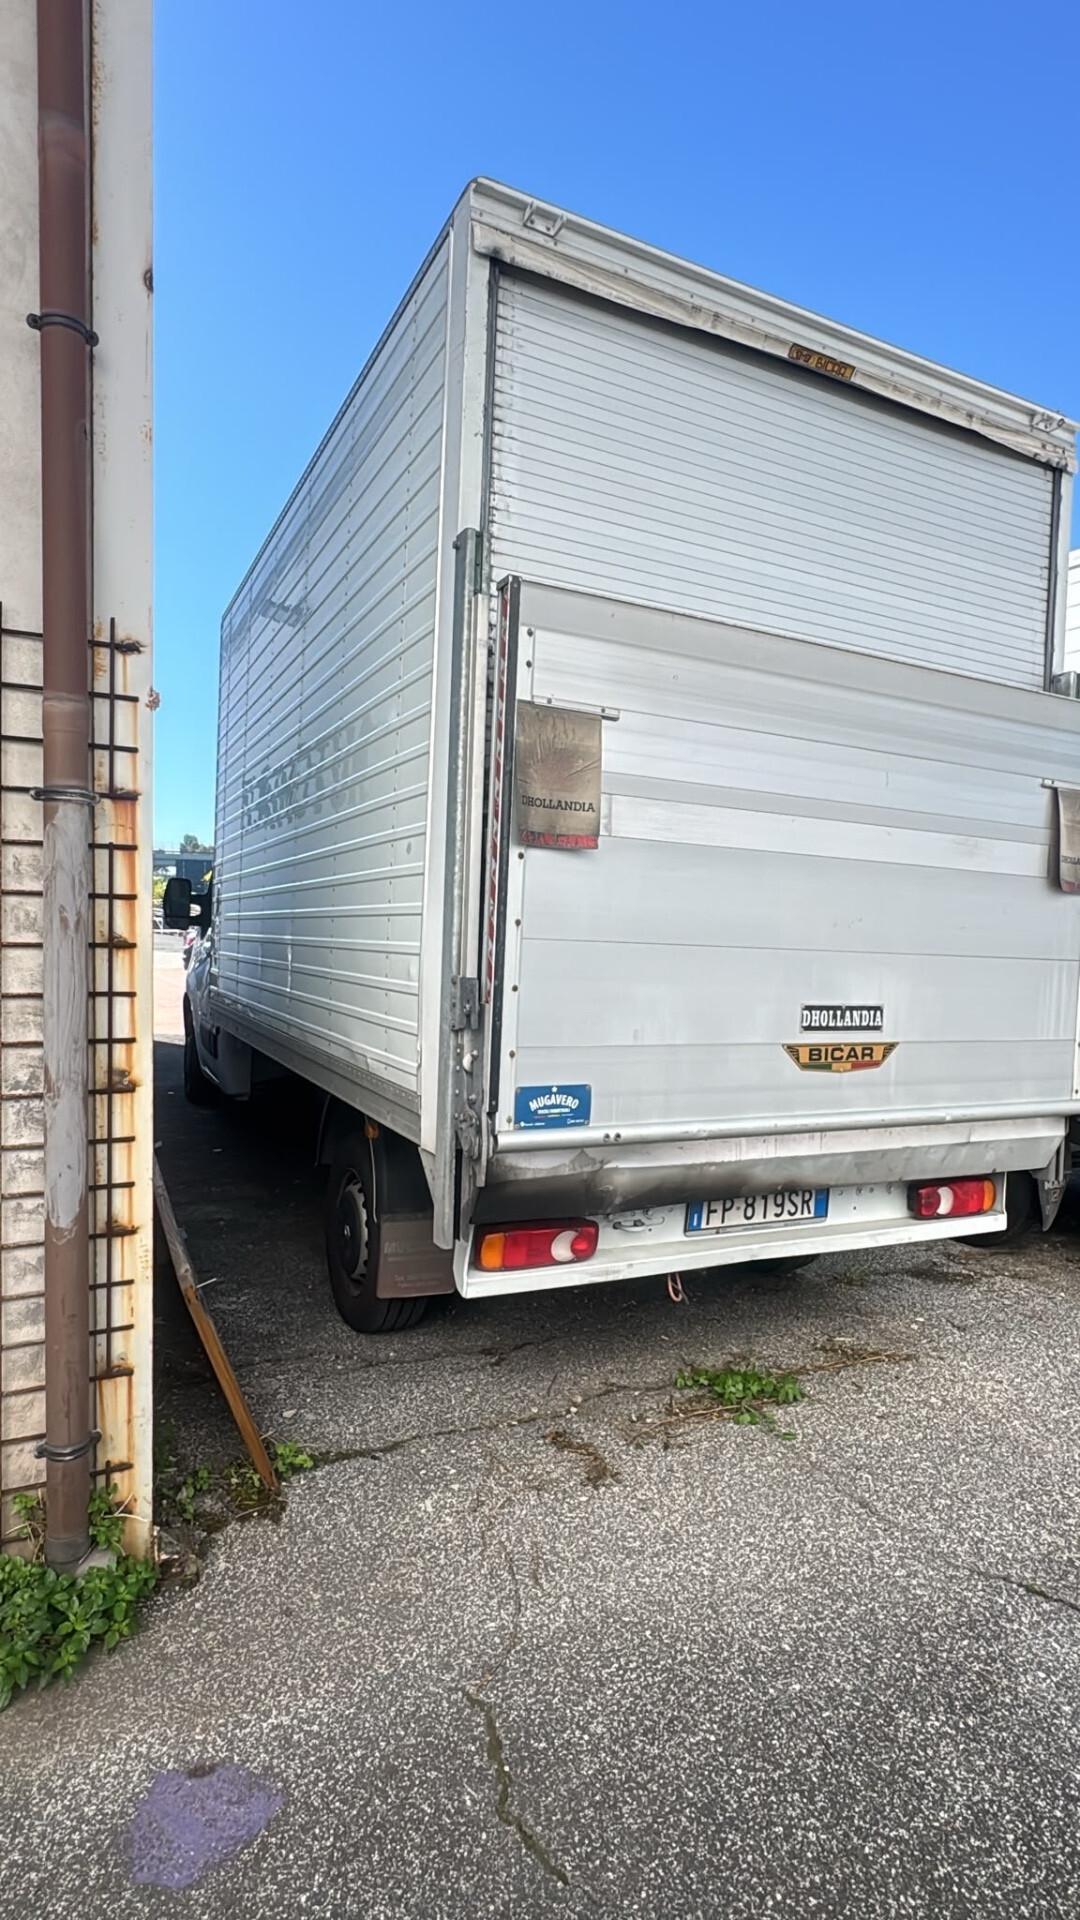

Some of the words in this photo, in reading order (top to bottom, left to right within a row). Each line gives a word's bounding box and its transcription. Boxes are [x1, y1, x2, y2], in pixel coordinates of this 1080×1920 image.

[521, 795, 596, 812] DHOLLANDIA
[802, 1010, 882, 1027] DHOLLANDIA
[808, 1047, 874, 1061] BICAR
[529, 1094, 579, 1112] MUGAVERO
